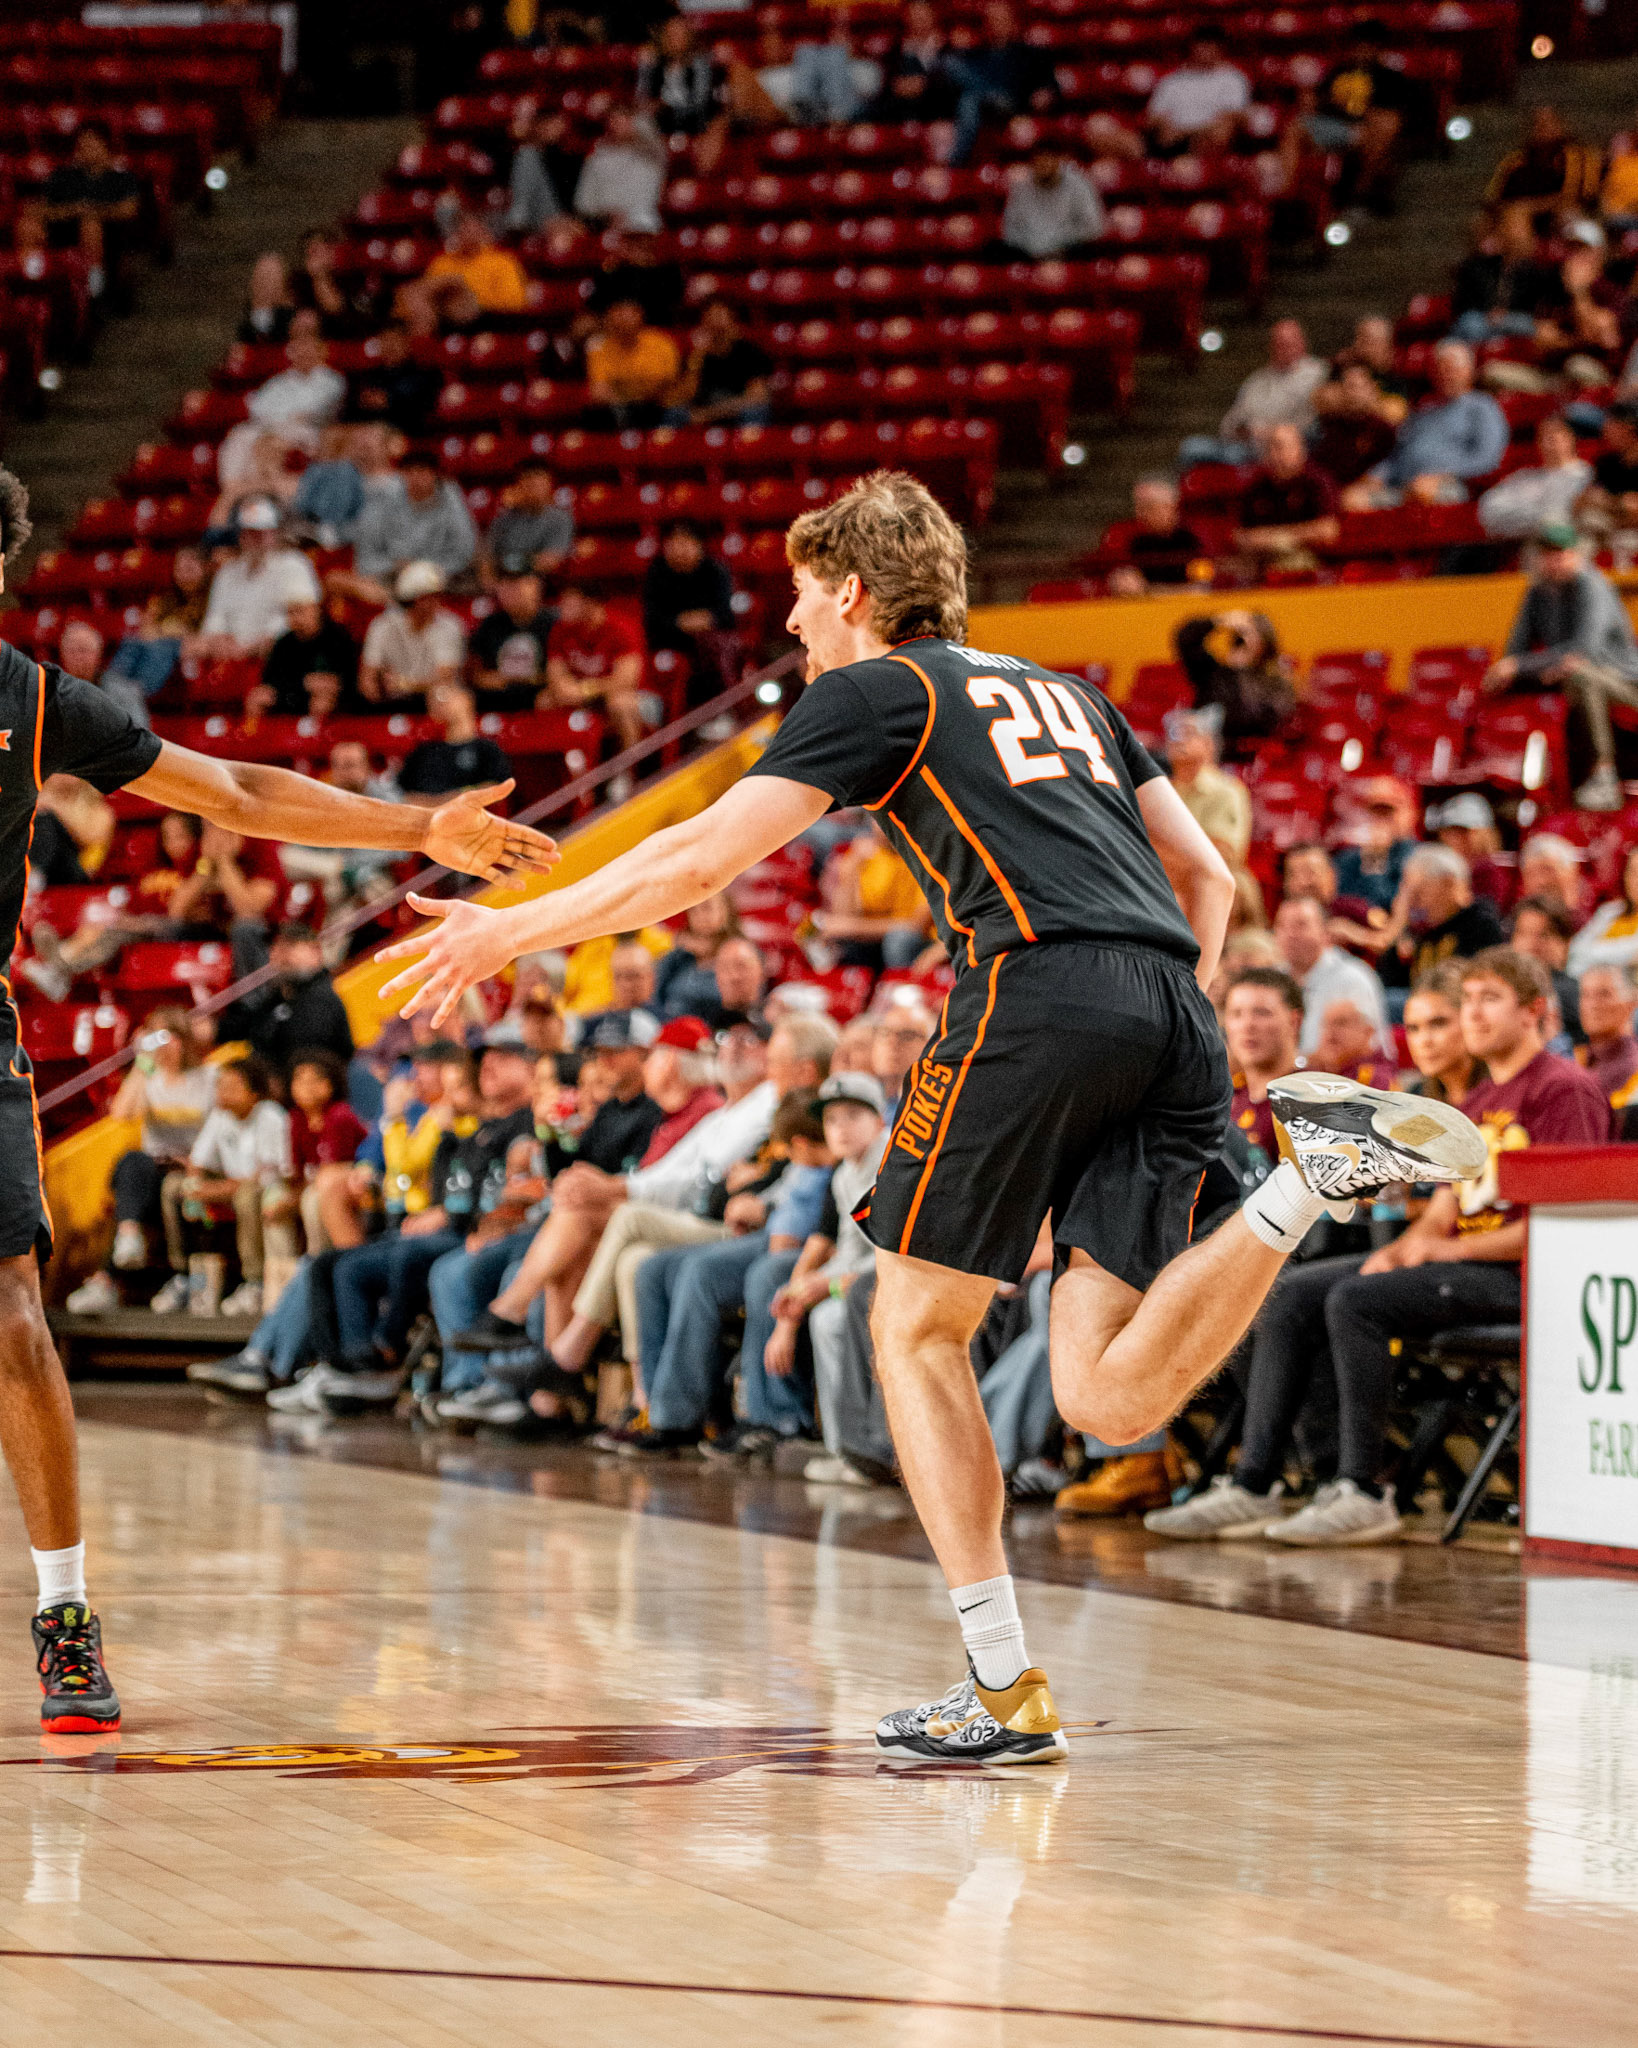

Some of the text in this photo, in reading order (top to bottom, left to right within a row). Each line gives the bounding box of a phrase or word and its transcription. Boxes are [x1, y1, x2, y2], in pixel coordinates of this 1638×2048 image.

[965, 675, 1120, 788] 24
[895, 1057, 953, 1160] POKES
[1577, 1273, 1637, 1393] SP
